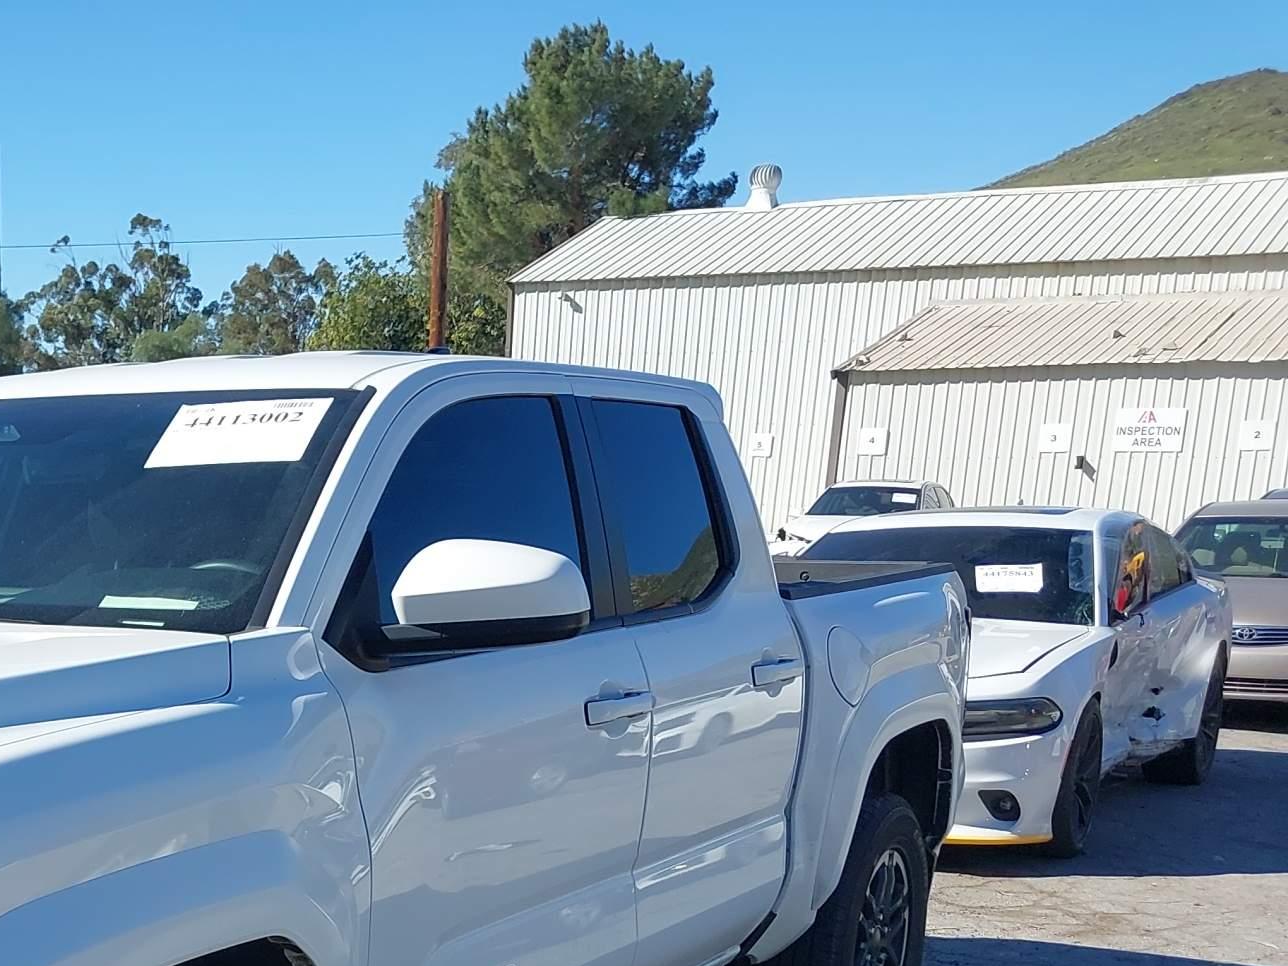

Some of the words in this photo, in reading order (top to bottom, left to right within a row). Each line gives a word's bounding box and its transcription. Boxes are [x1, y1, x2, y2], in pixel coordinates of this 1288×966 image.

[184, 411, 304, 428] 44113002
[1116, 426, 1181, 436] INSPECTION
[1253, 430, 1261, 439] 2
[868, 436, 875, 444] 4
[1132, 437, 1162, 447] AREA
